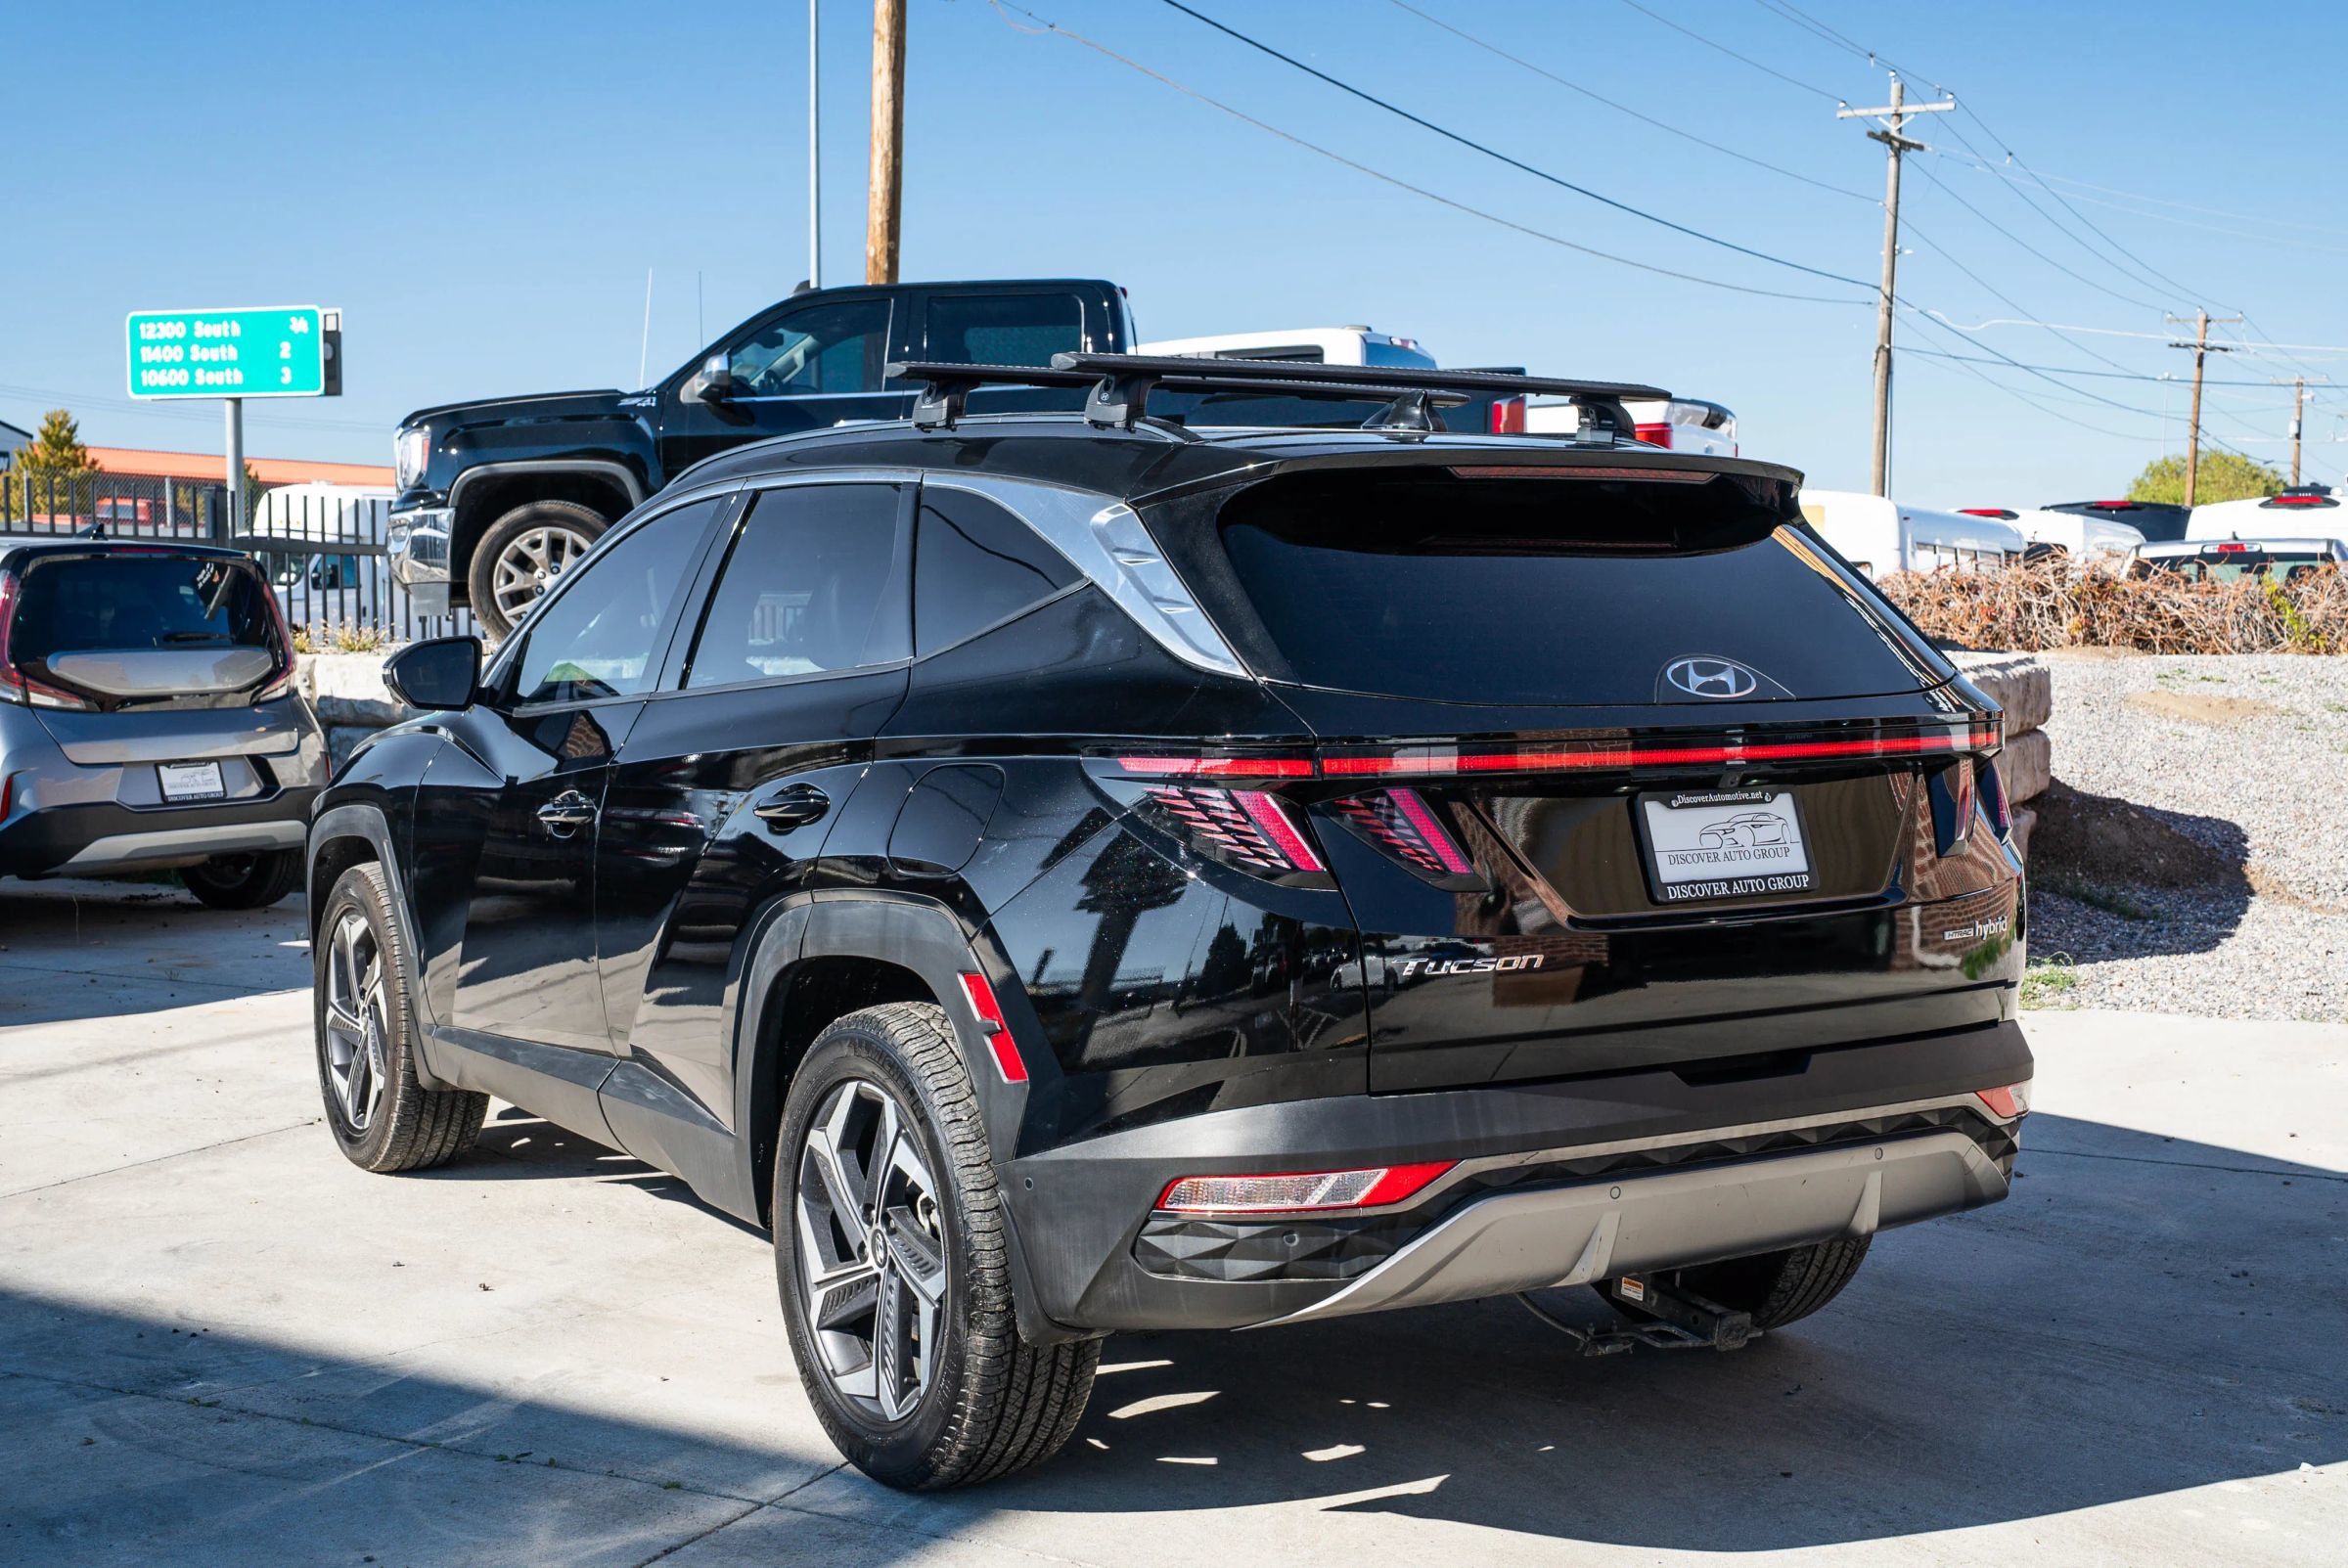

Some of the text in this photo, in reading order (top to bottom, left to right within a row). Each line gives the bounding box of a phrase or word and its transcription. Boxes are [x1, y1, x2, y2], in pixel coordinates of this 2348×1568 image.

[139, 322, 187, 339] 12300
[194, 320, 242, 337] South
[140, 341, 292, 363] 11400 South 2
[141, 367, 292, 386] 10600 South 3
[1677, 790, 1764, 804] DiscoverAutomotive.net
[1667, 846, 1790, 866] DISCOVER AUTO GROUP
[1667, 874, 1810, 900] DISCOVER AUTO GROUP
[1975, 916, 2008, 940] hybrid
